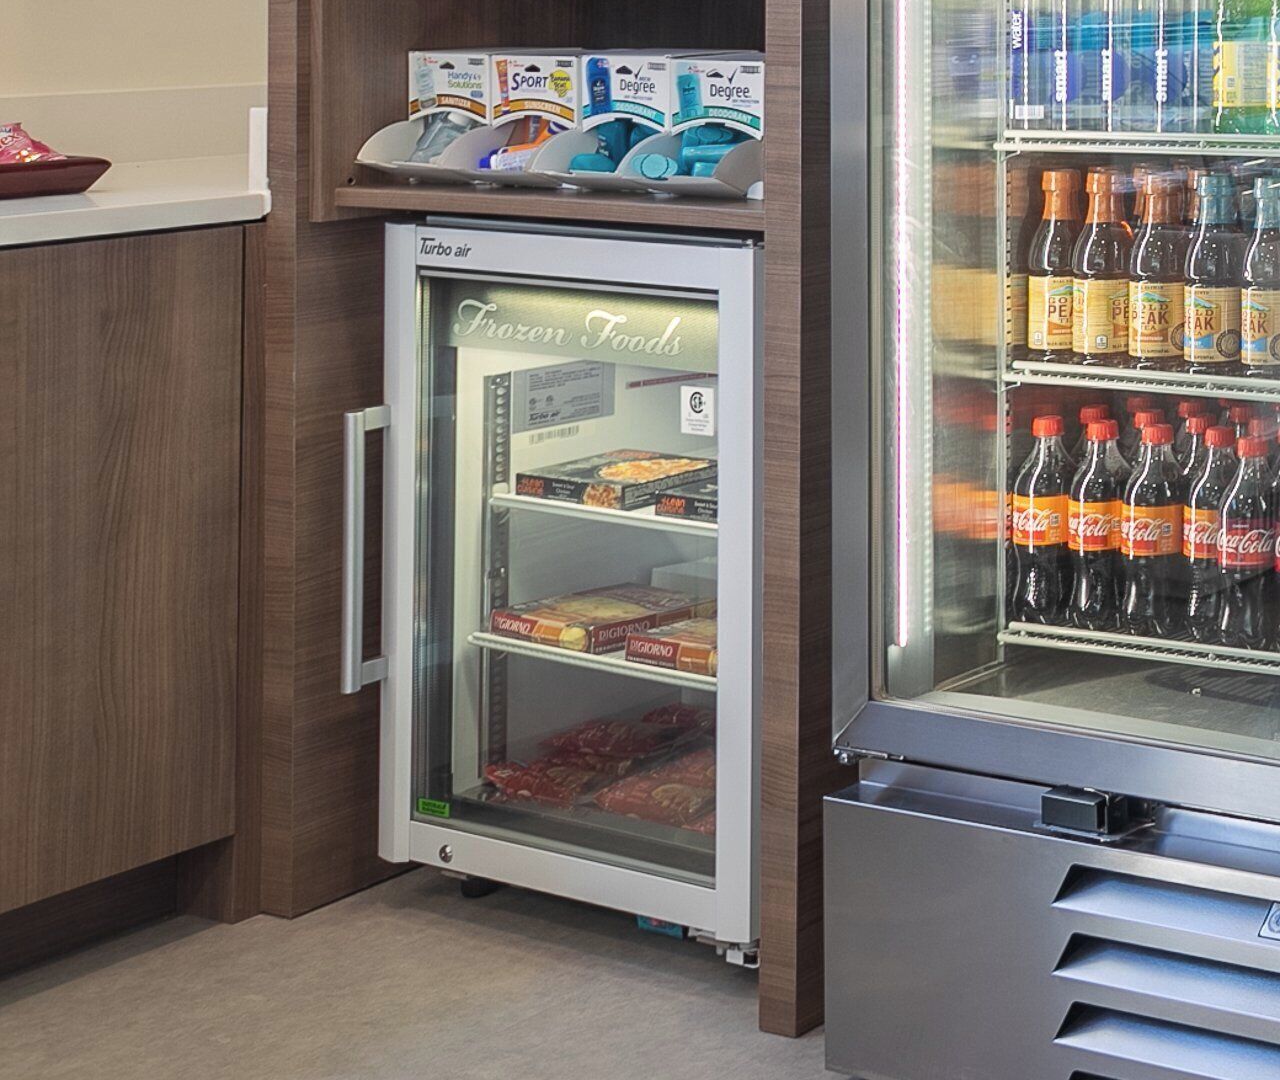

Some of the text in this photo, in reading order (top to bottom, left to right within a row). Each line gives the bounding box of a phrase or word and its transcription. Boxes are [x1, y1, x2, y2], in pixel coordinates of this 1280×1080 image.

[1012, 11, 1022, 49] water
[448, 72, 472, 82] Handy
[448, 80, 482, 89] Solutions
[511, 73, 549, 91] SPORT
[620, 79, 655, 95] Degree
[710, 84, 751, 101] Degree
[524, 102, 561, 113] SUNSCREEN
[709, 109, 753, 123] DEODORANT
[420, 238, 472, 258] Turbo air
[453, 298, 684, 357] Frozen Foods
[1217, 526, 1276, 555] Coca-Cola
